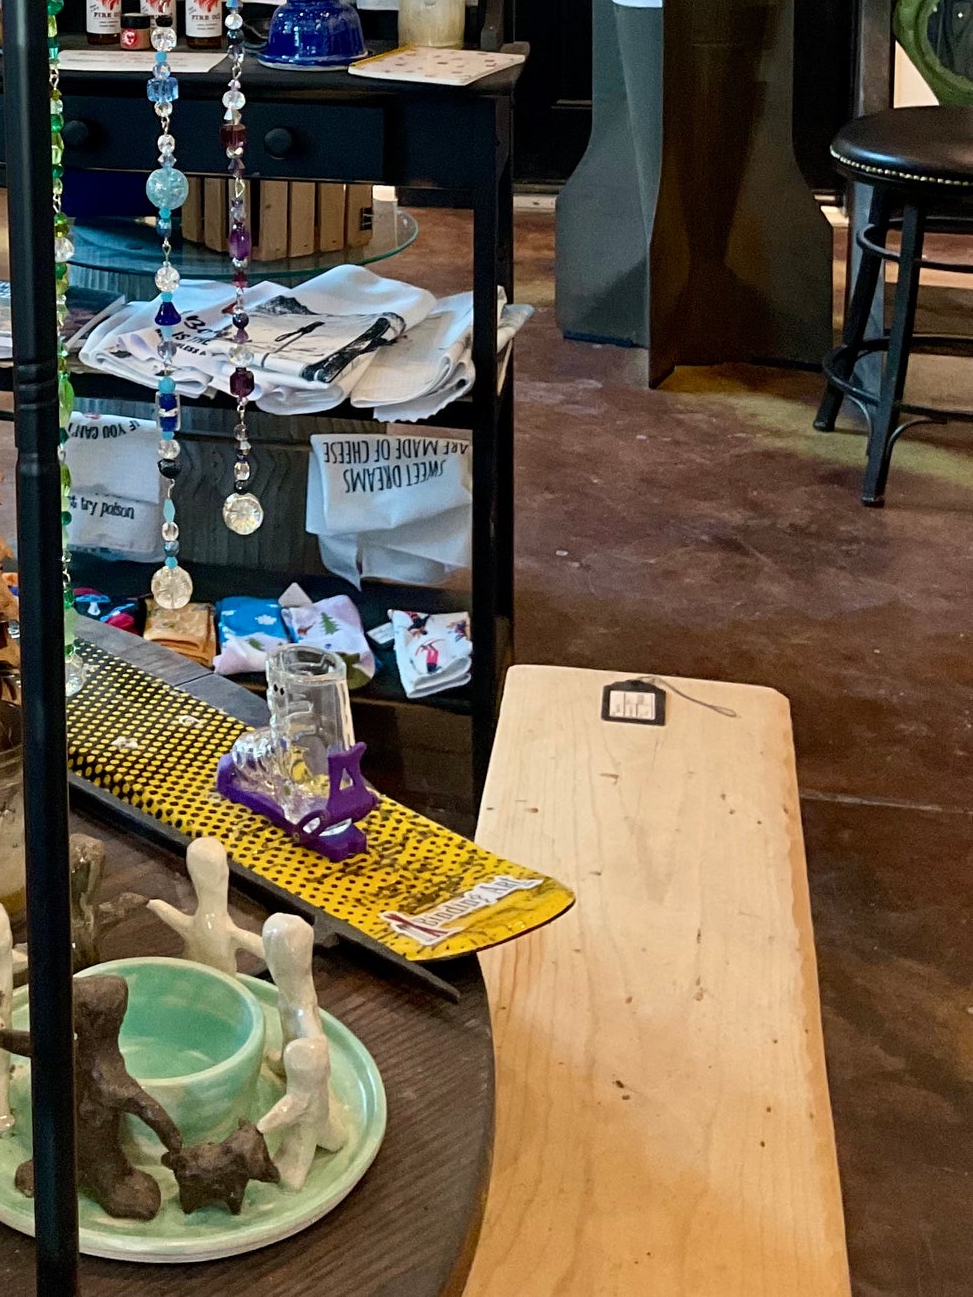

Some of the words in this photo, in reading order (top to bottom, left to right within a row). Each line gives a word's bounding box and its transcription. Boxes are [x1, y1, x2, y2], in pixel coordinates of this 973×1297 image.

[102, 422, 127, 439] YOU
[323, 440, 370, 465] CHEESE
[374, 438, 391, 463] OF
[395, 438, 439, 460] MADE
[343, 464, 402, 494] DREAMS
[406, 459, 446, 487] SWEET
[80, 496, 98, 516] try
[99, 502, 135, 520] poison
